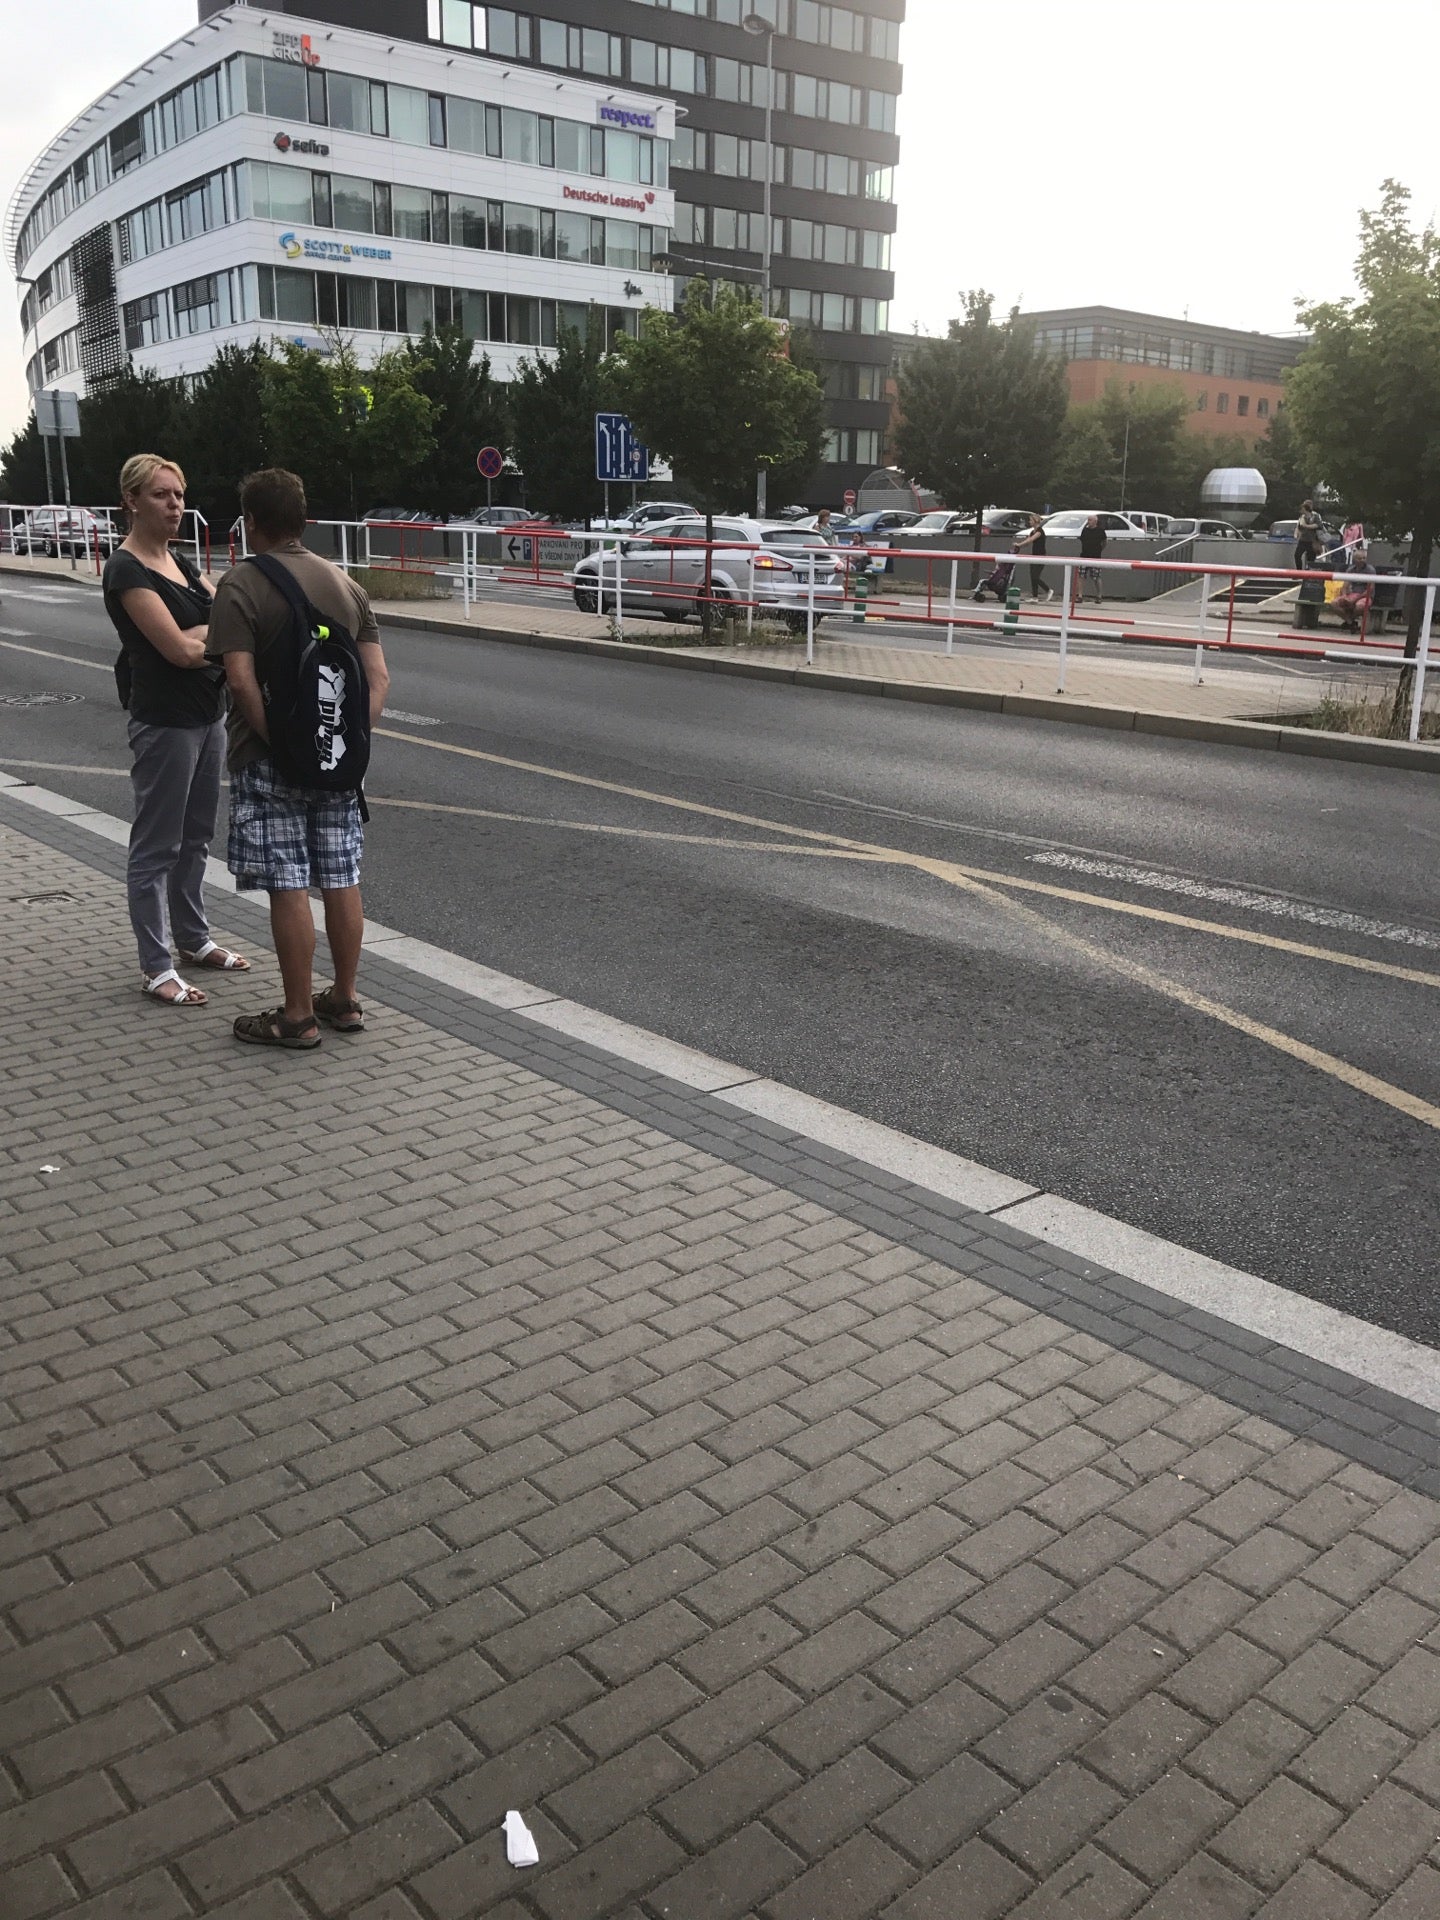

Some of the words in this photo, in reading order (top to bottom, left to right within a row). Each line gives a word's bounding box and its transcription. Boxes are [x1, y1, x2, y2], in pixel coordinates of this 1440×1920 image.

[273, 47, 321, 66] GROUP
[563, 186, 609, 204] Deutsche
[610, 194, 646, 212] Leasing
